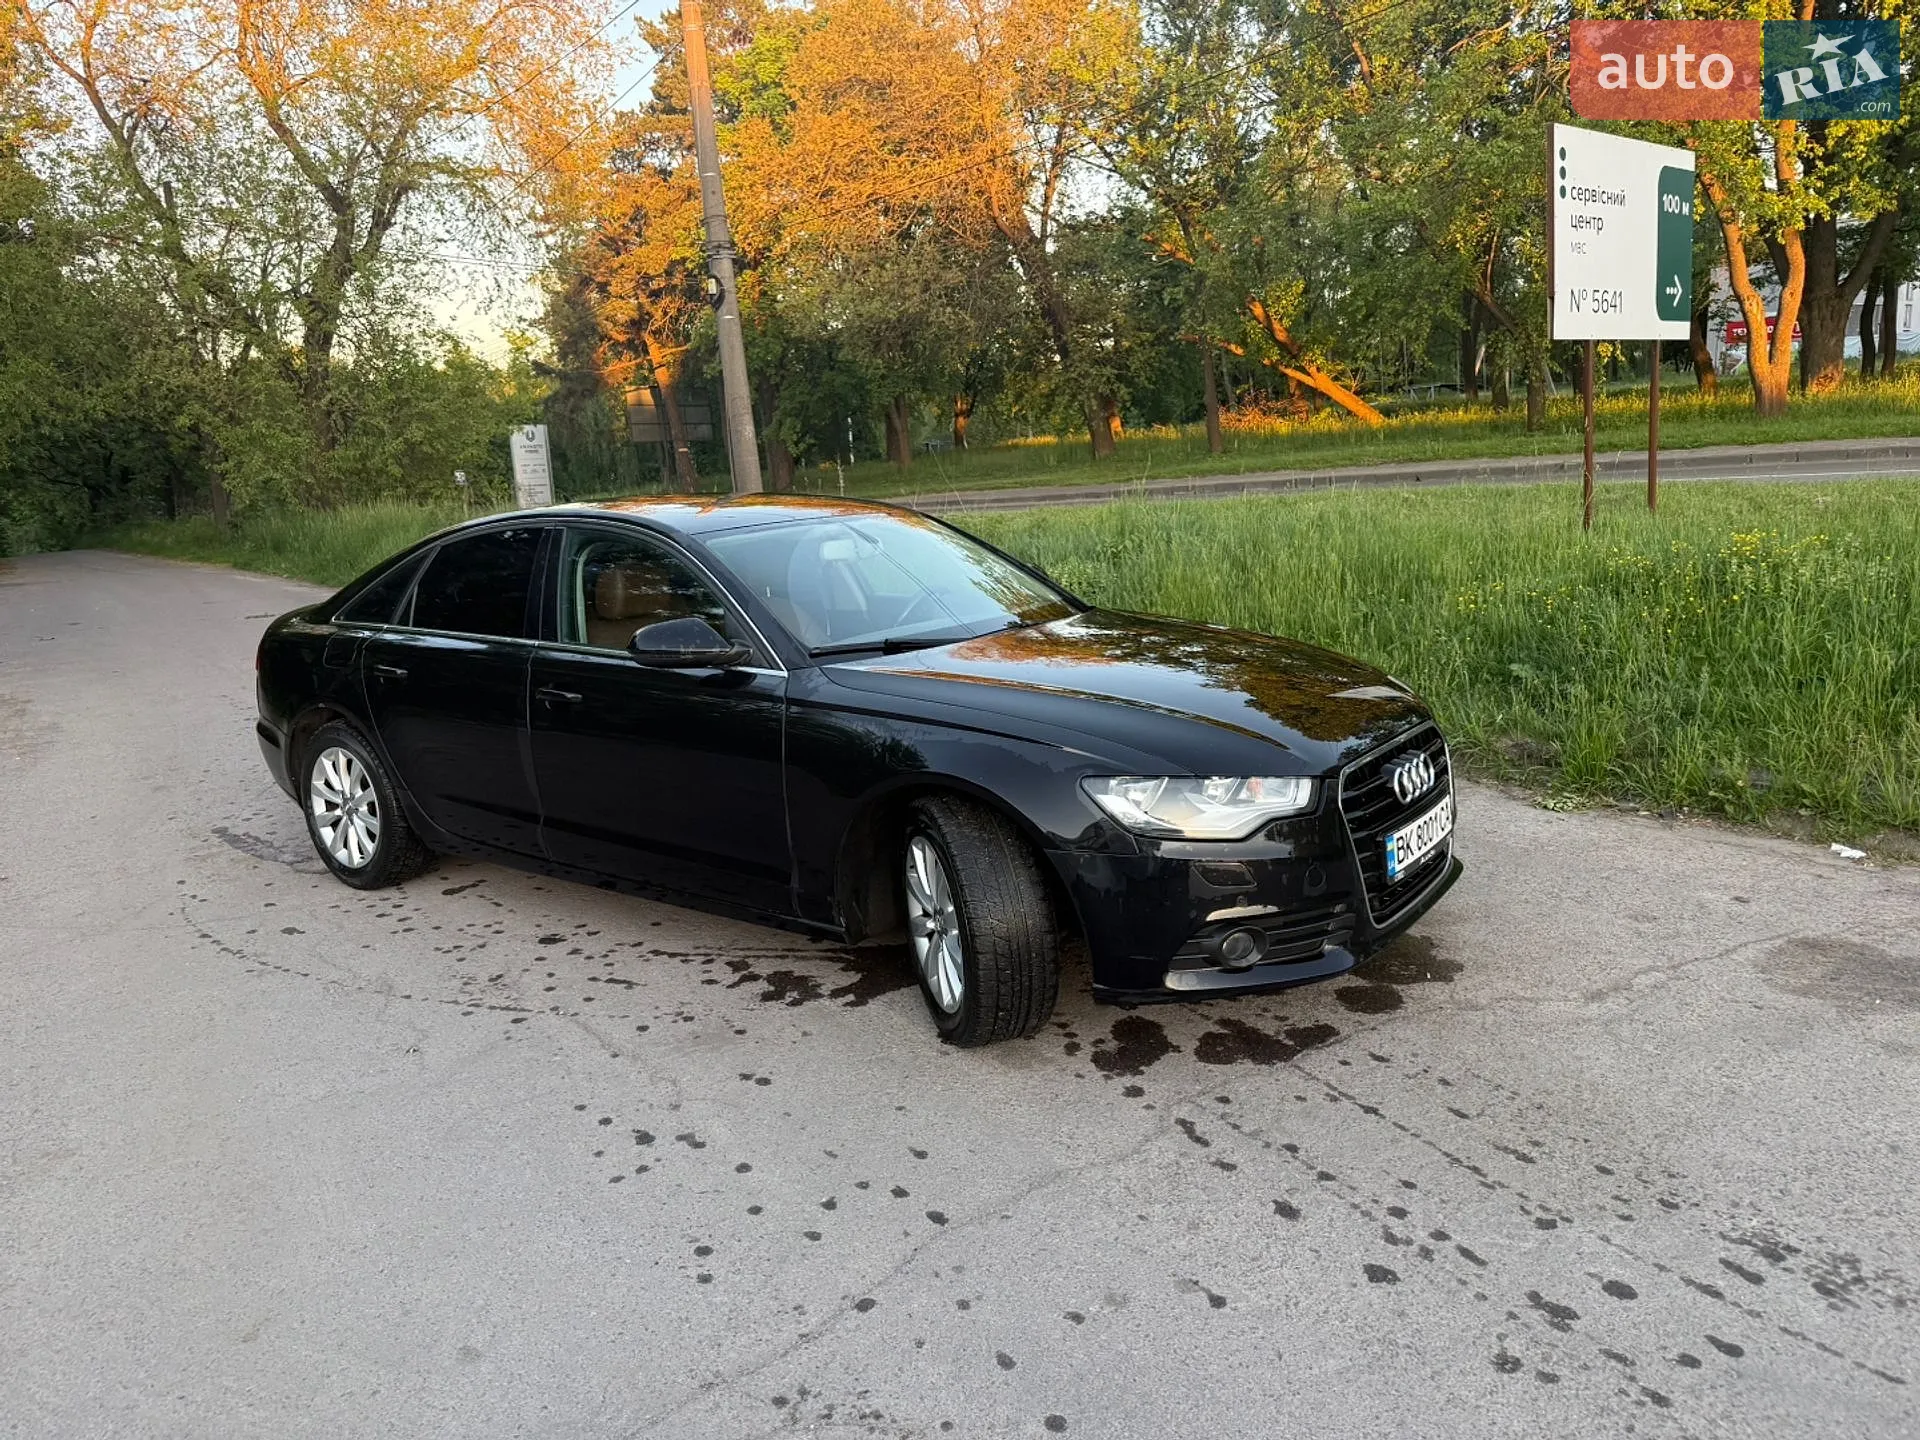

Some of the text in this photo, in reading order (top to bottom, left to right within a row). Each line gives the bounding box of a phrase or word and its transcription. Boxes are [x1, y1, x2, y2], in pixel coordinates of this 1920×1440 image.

[1570, 185, 1626, 207] сервісний
[1662, 193, 1681, 215] 100
[1570, 213, 1604, 236] центр
[1591, 288, 1623, 314] 5641
[1396, 828, 1414, 865] BK
